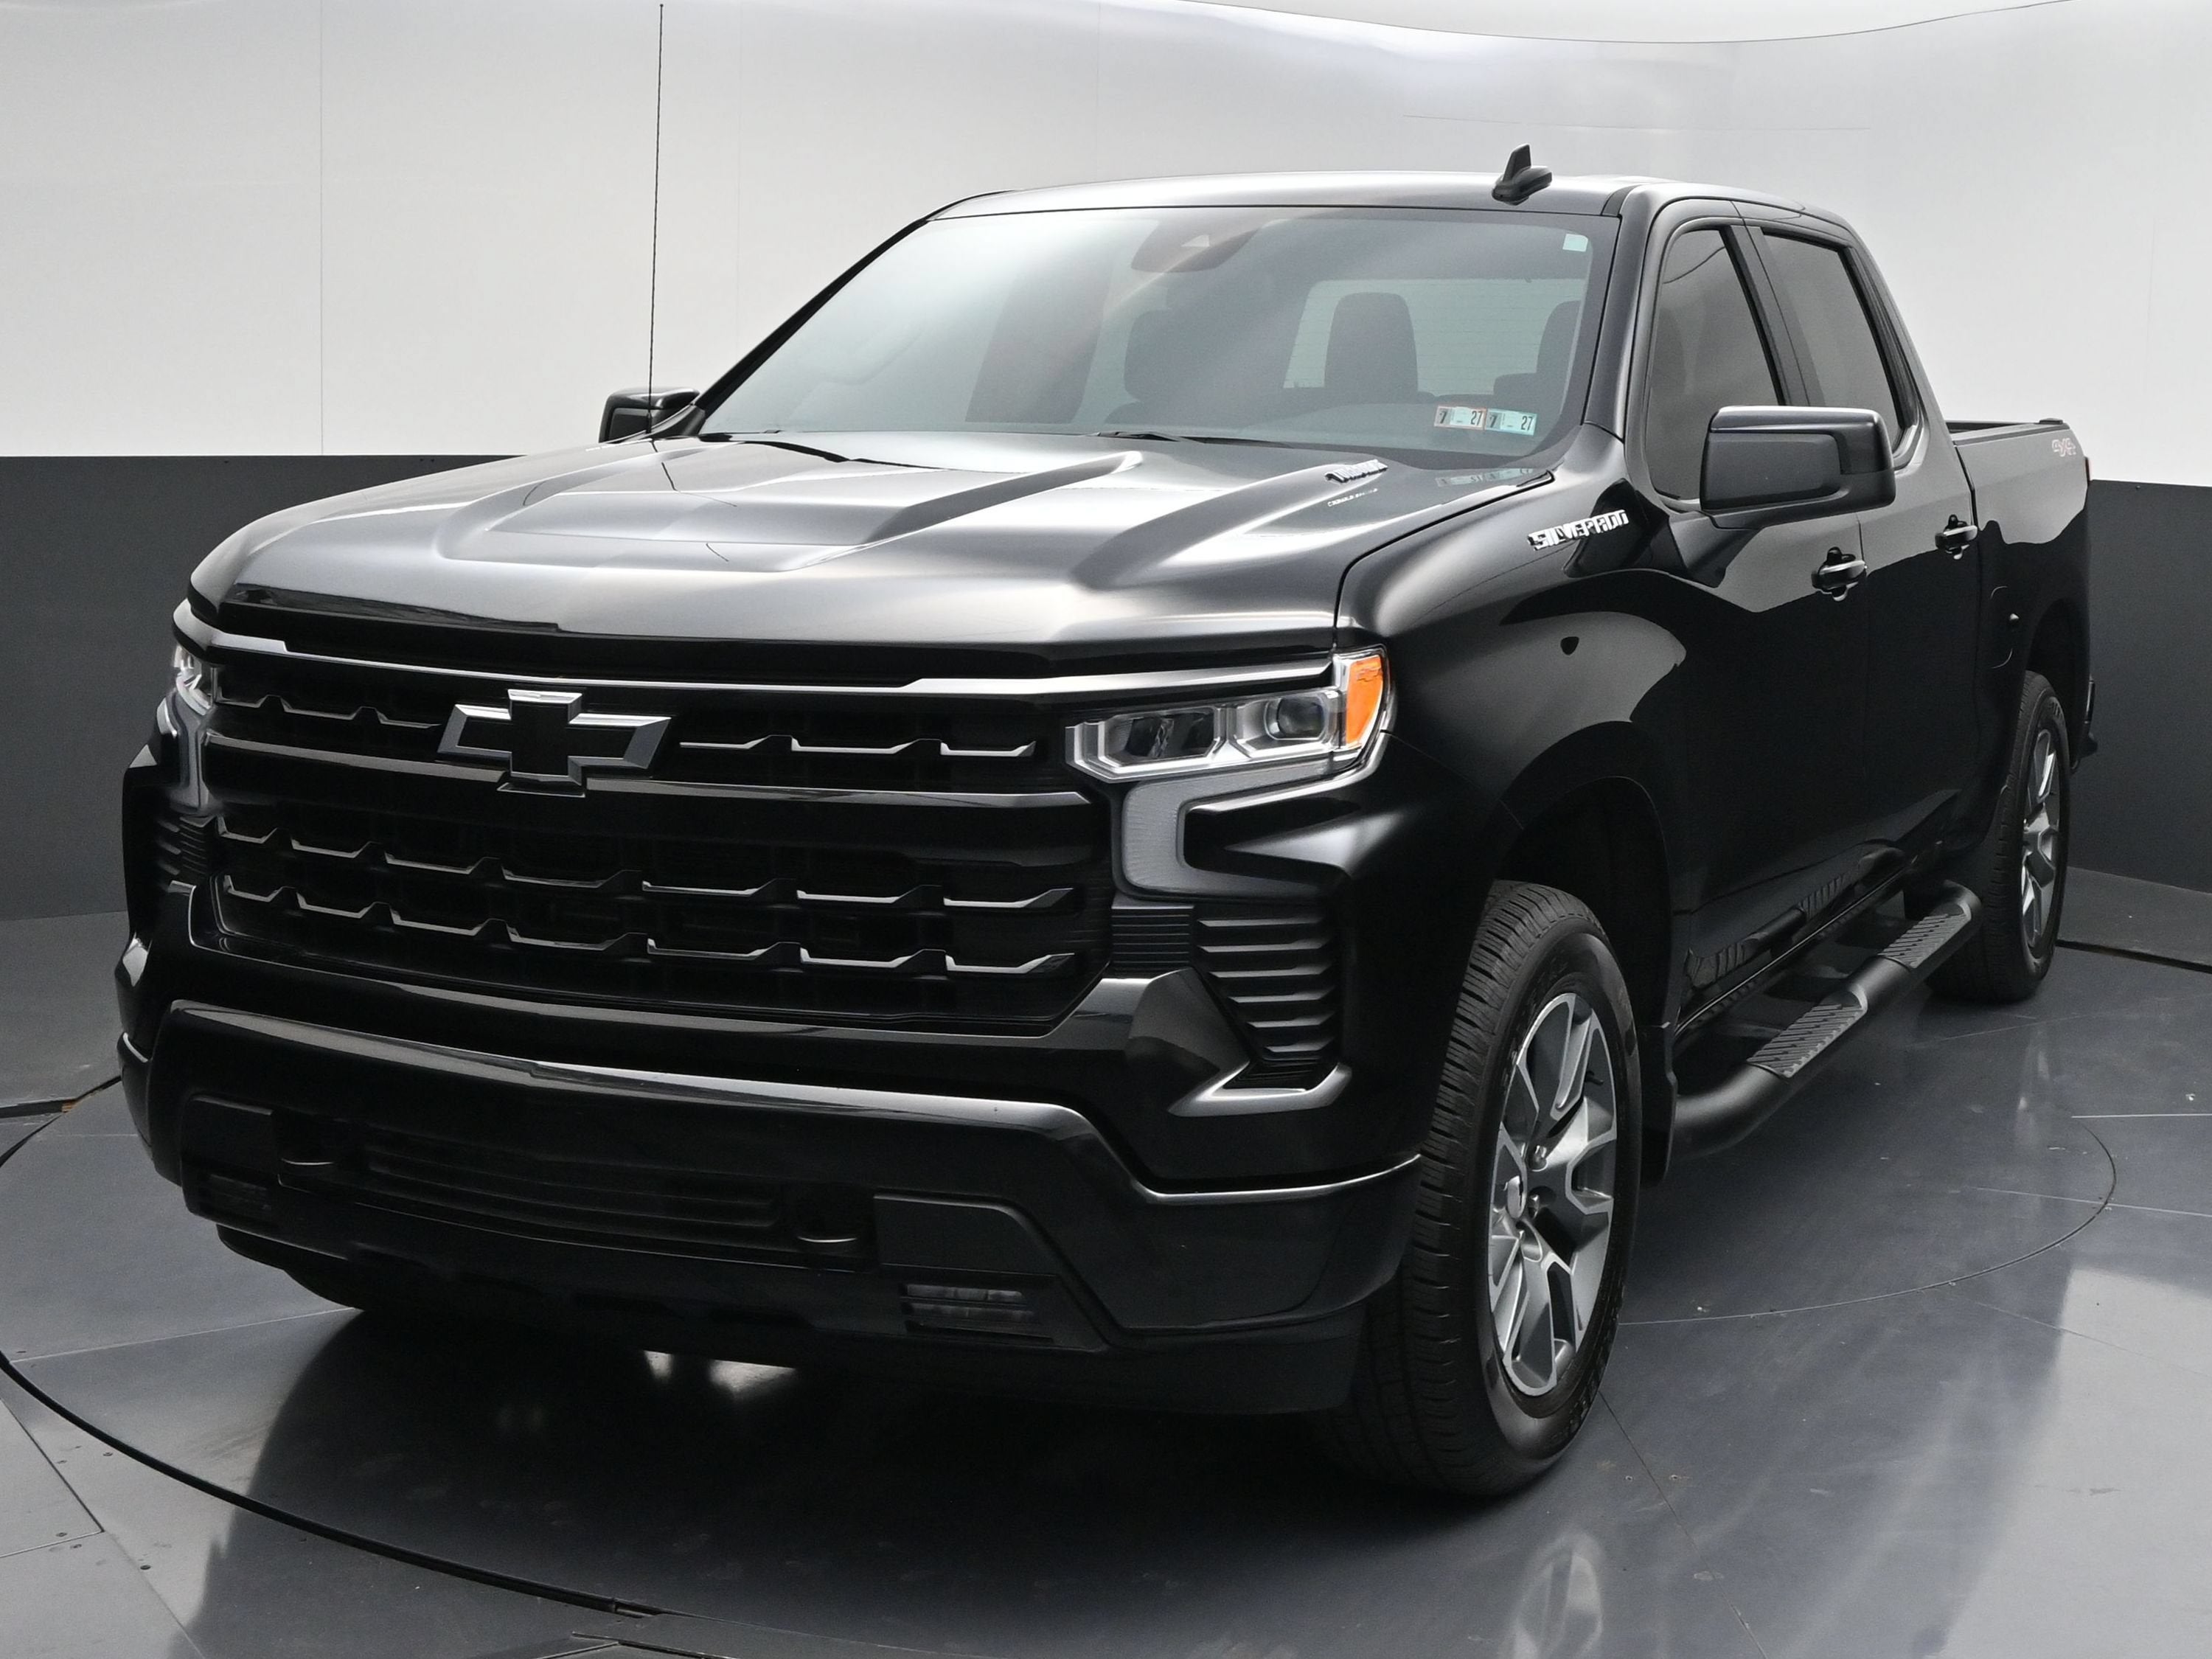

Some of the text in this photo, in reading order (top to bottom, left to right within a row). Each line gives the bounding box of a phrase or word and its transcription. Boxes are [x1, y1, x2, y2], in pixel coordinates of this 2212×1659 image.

[1470, 411, 1484, 427] 27
[1520, 415, 1534, 431] 27
[1527, 509, 1630, 551] SILVERADO
